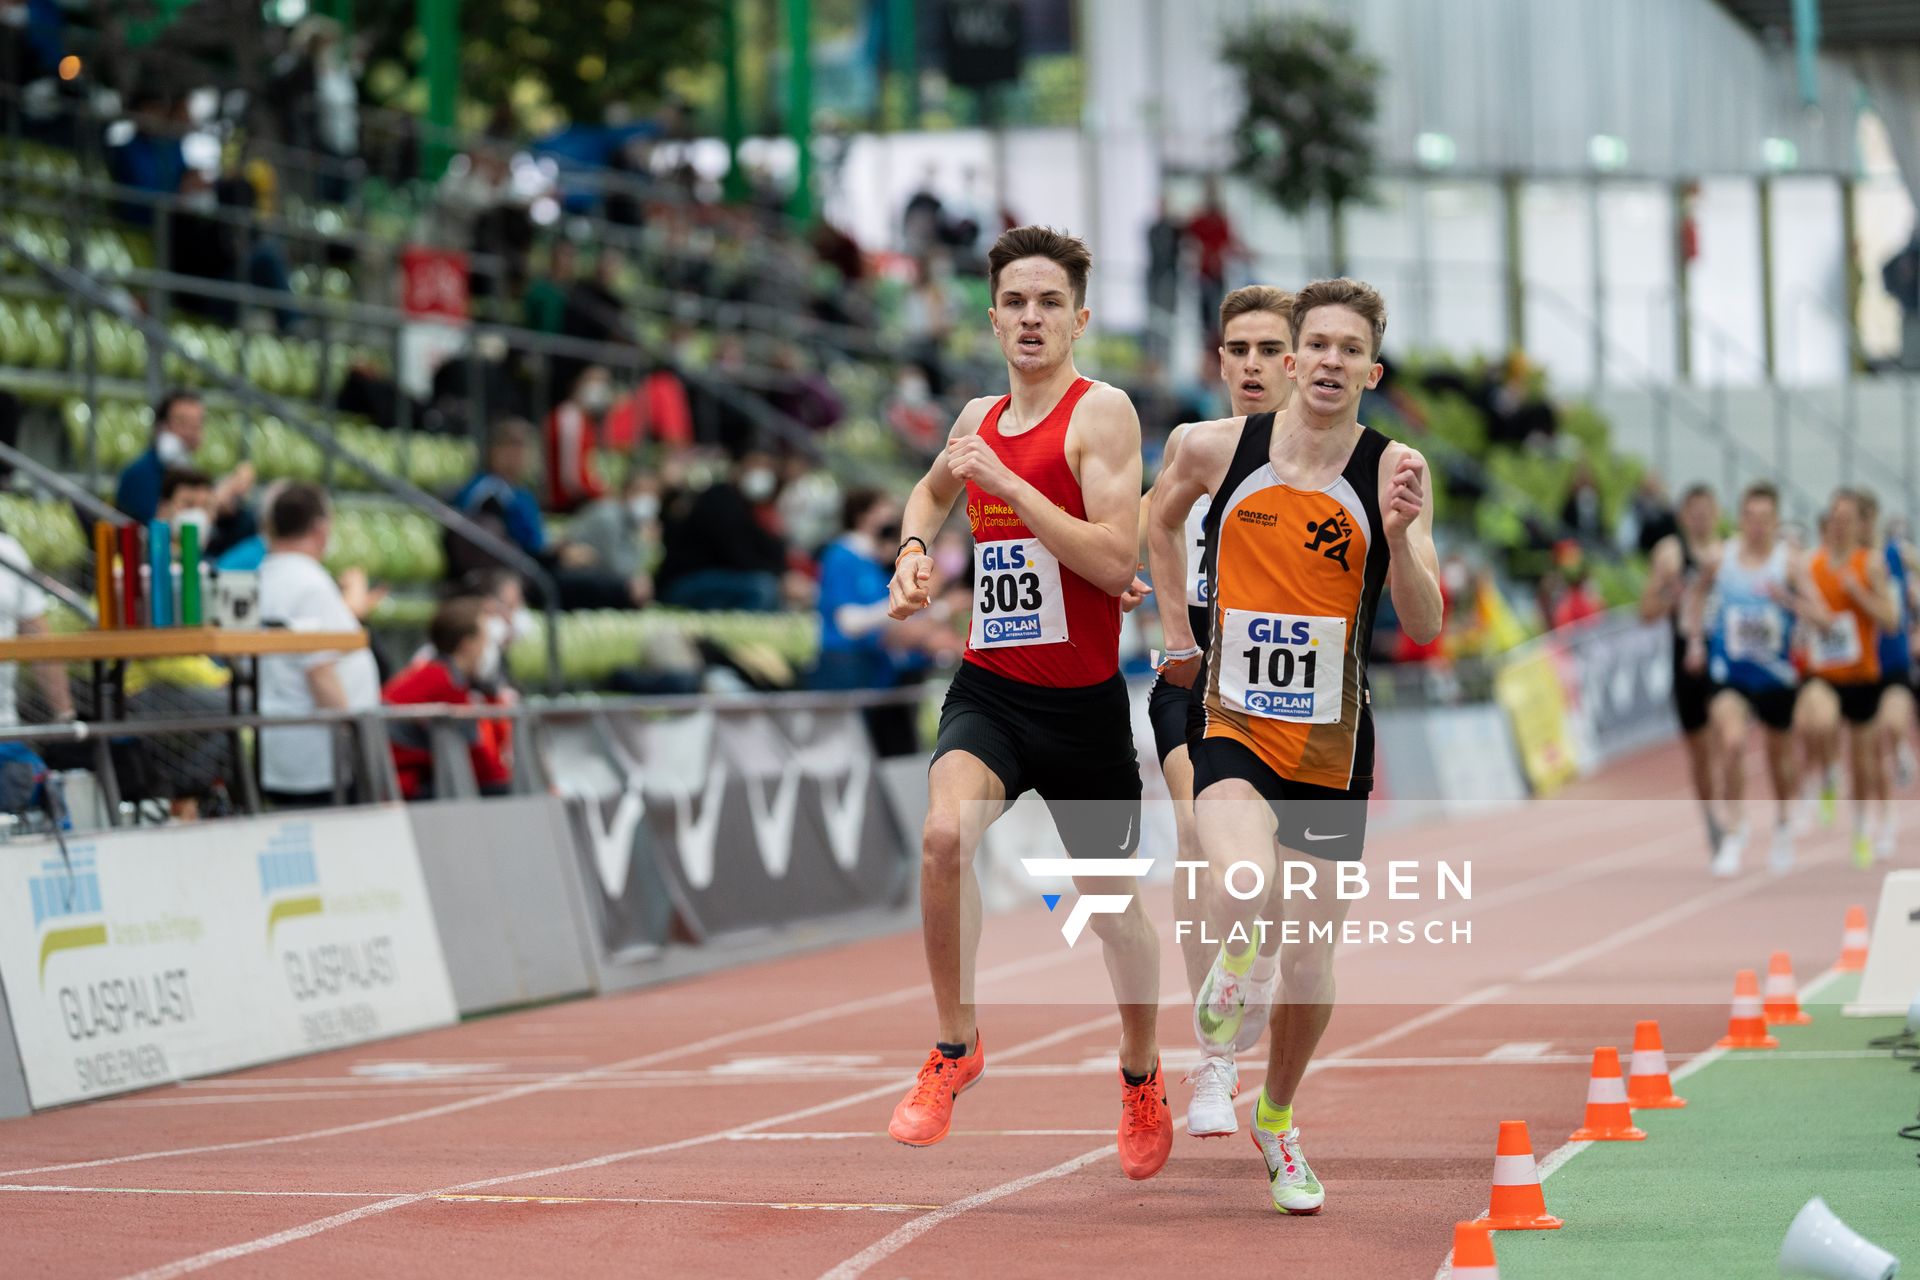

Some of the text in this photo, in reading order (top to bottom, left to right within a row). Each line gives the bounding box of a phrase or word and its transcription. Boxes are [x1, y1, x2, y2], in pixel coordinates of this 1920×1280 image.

[1237, 509, 1278, 522] panzeri
[1262, 520, 1277, 528] sport
[1335, 508, 1353, 538] TVA
[980, 572, 1042, 614] 303
[1005, 619, 1038, 632] PLAN
[1243, 646, 1317, 688] 101
[1273, 696, 1311, 709] PLAN
[58, 969, 196, 1041] GLASPALAST
